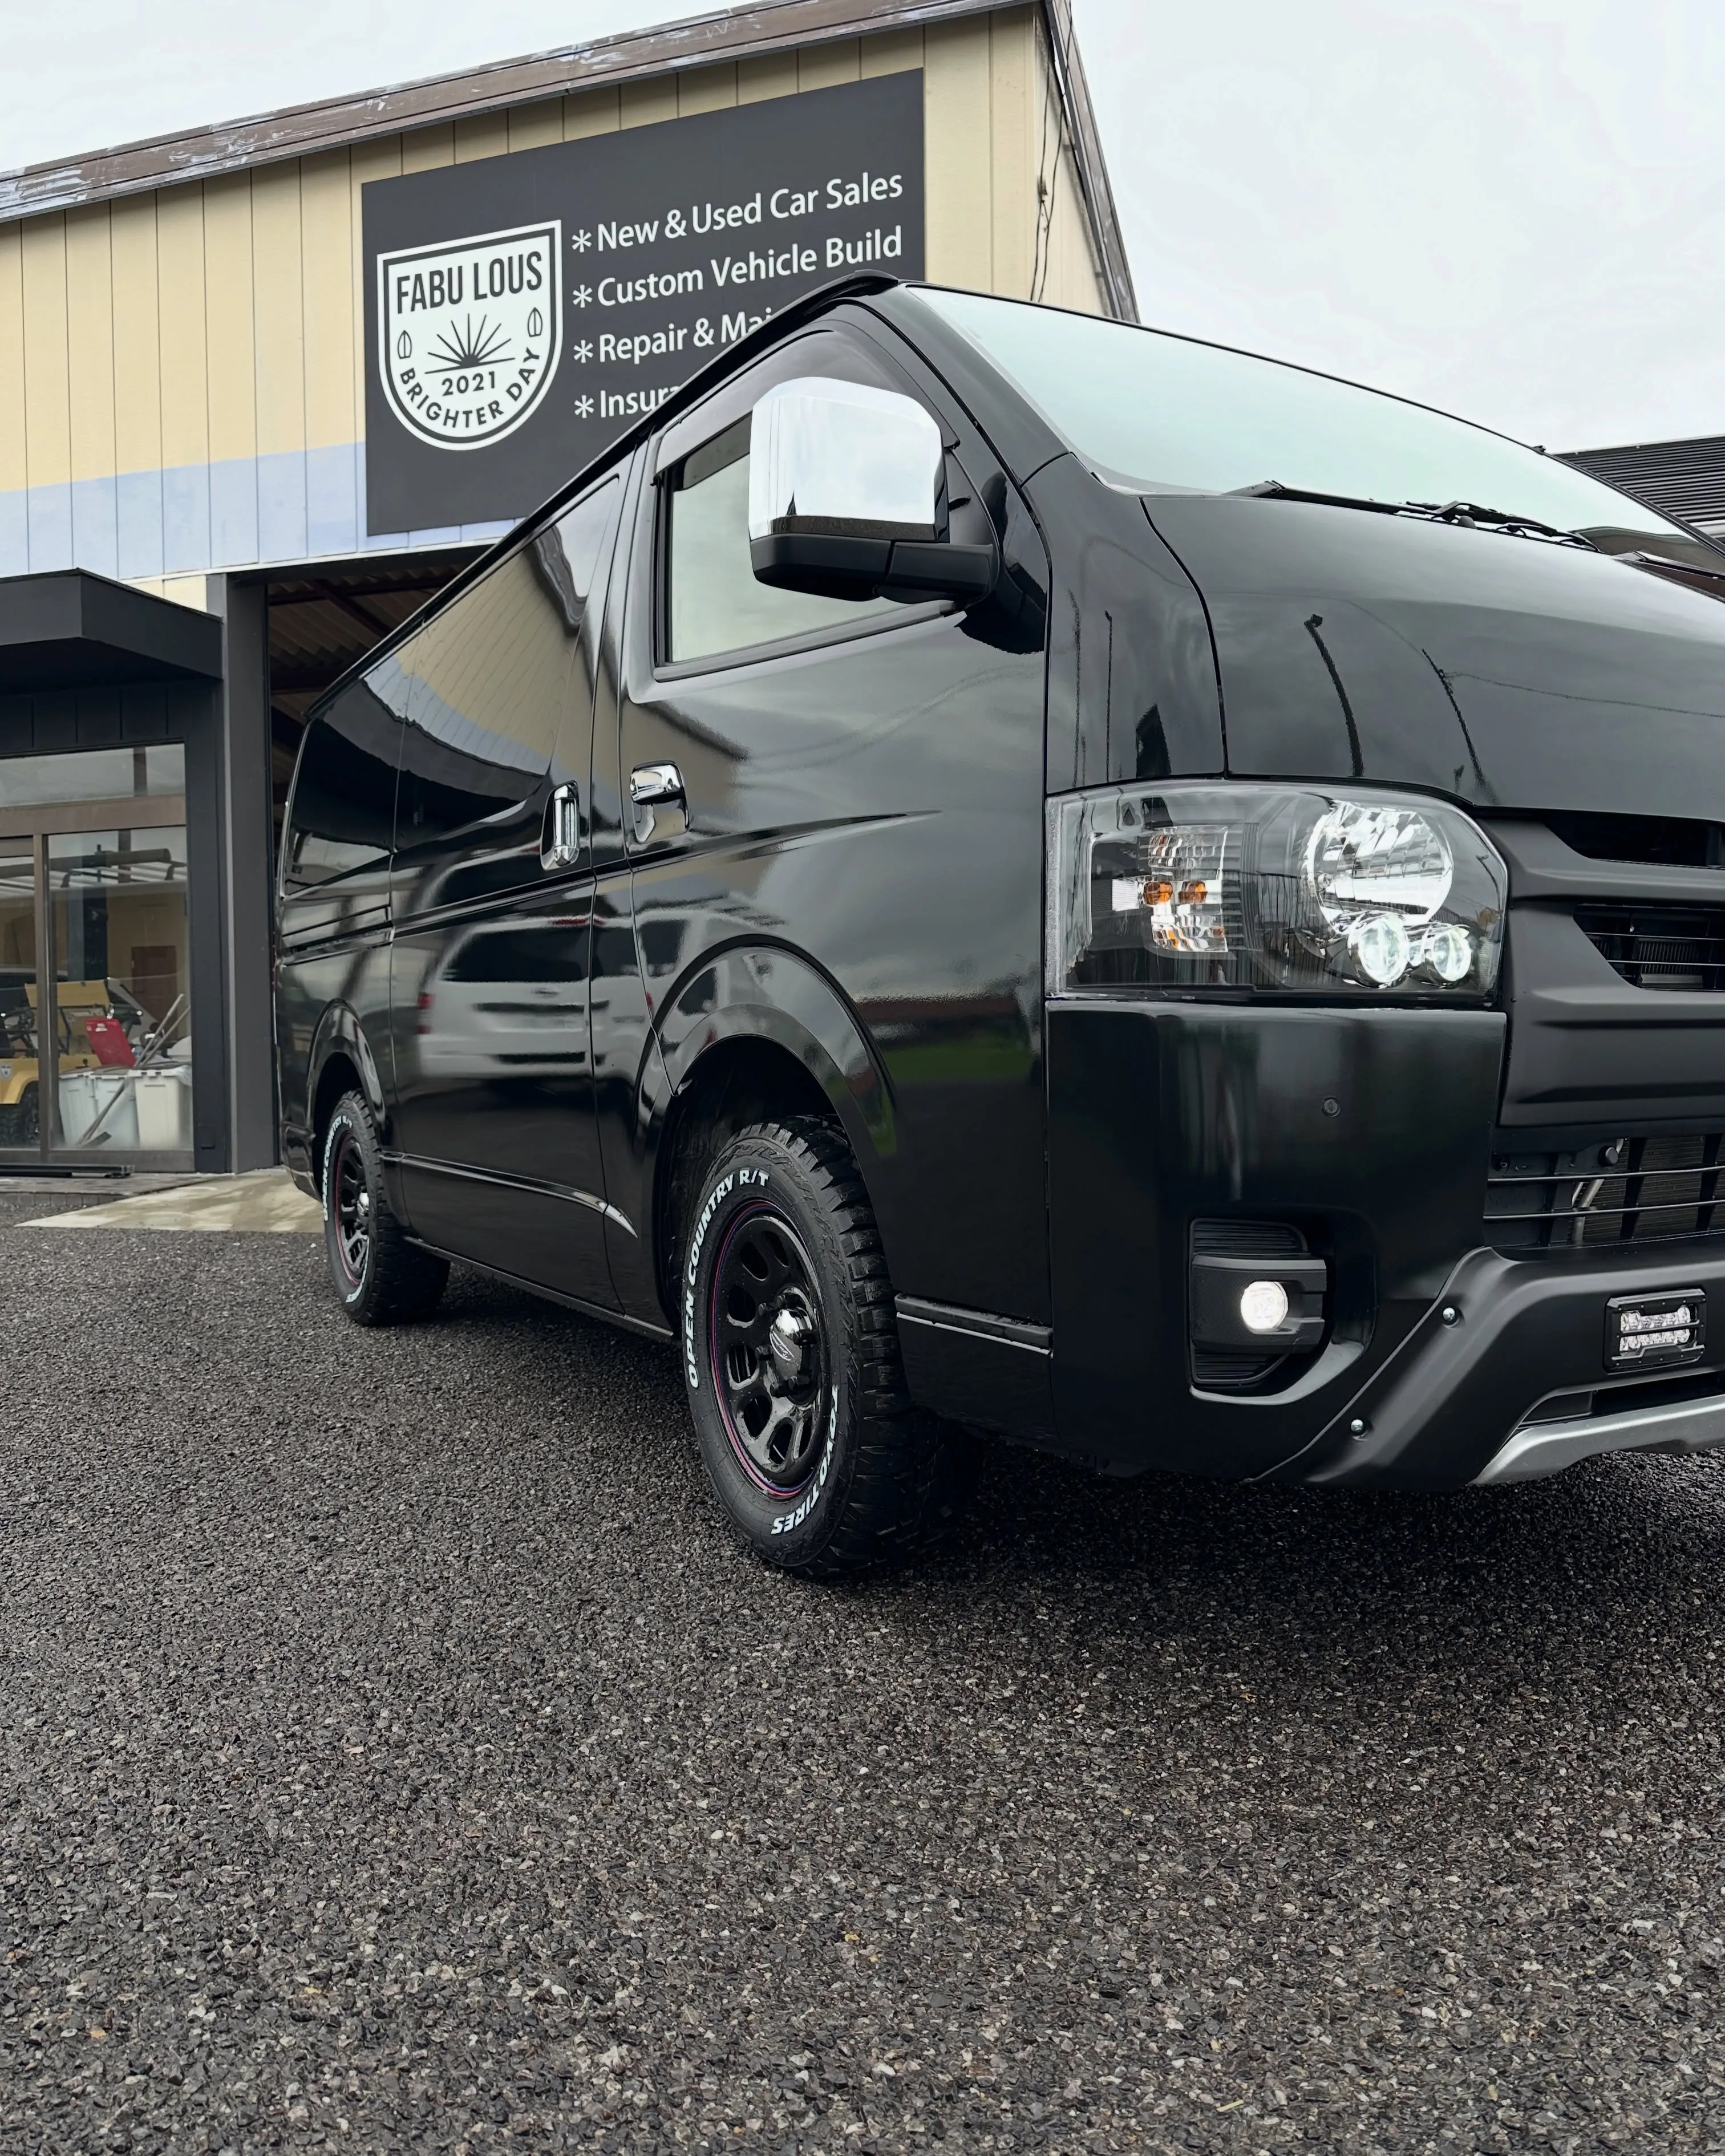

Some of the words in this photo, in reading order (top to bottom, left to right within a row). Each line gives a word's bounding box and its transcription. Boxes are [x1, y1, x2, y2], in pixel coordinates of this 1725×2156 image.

[598, 221, 659, 252] New
[663, 209, 687, 238] &
[692, 192, 762, 233] Used
[770, 188, 819, 219] Car
[826, 172, 903, 209] Sales
[597, 269, 703, 306] Custom
[711, 243, 817, 286] Vehicle
[826, 225, 902, 268] Build
[600, 322, 687, 364] Repair
[693, 317, 715, 347] &
[400, 367, 504, 428] BRIGHTER
[505, 346, 540, 402] DAY
[442, 371, 496, 396] 2021
[739, 1169, 770, 1186] R/T
[688, 1172, 735, 1286] COUNTRY
[685, 1288, 699, 1389] OPEN
[819, 1384, 839, 1486] TOYO
[771, 1482, 820, 1534] TIRES
